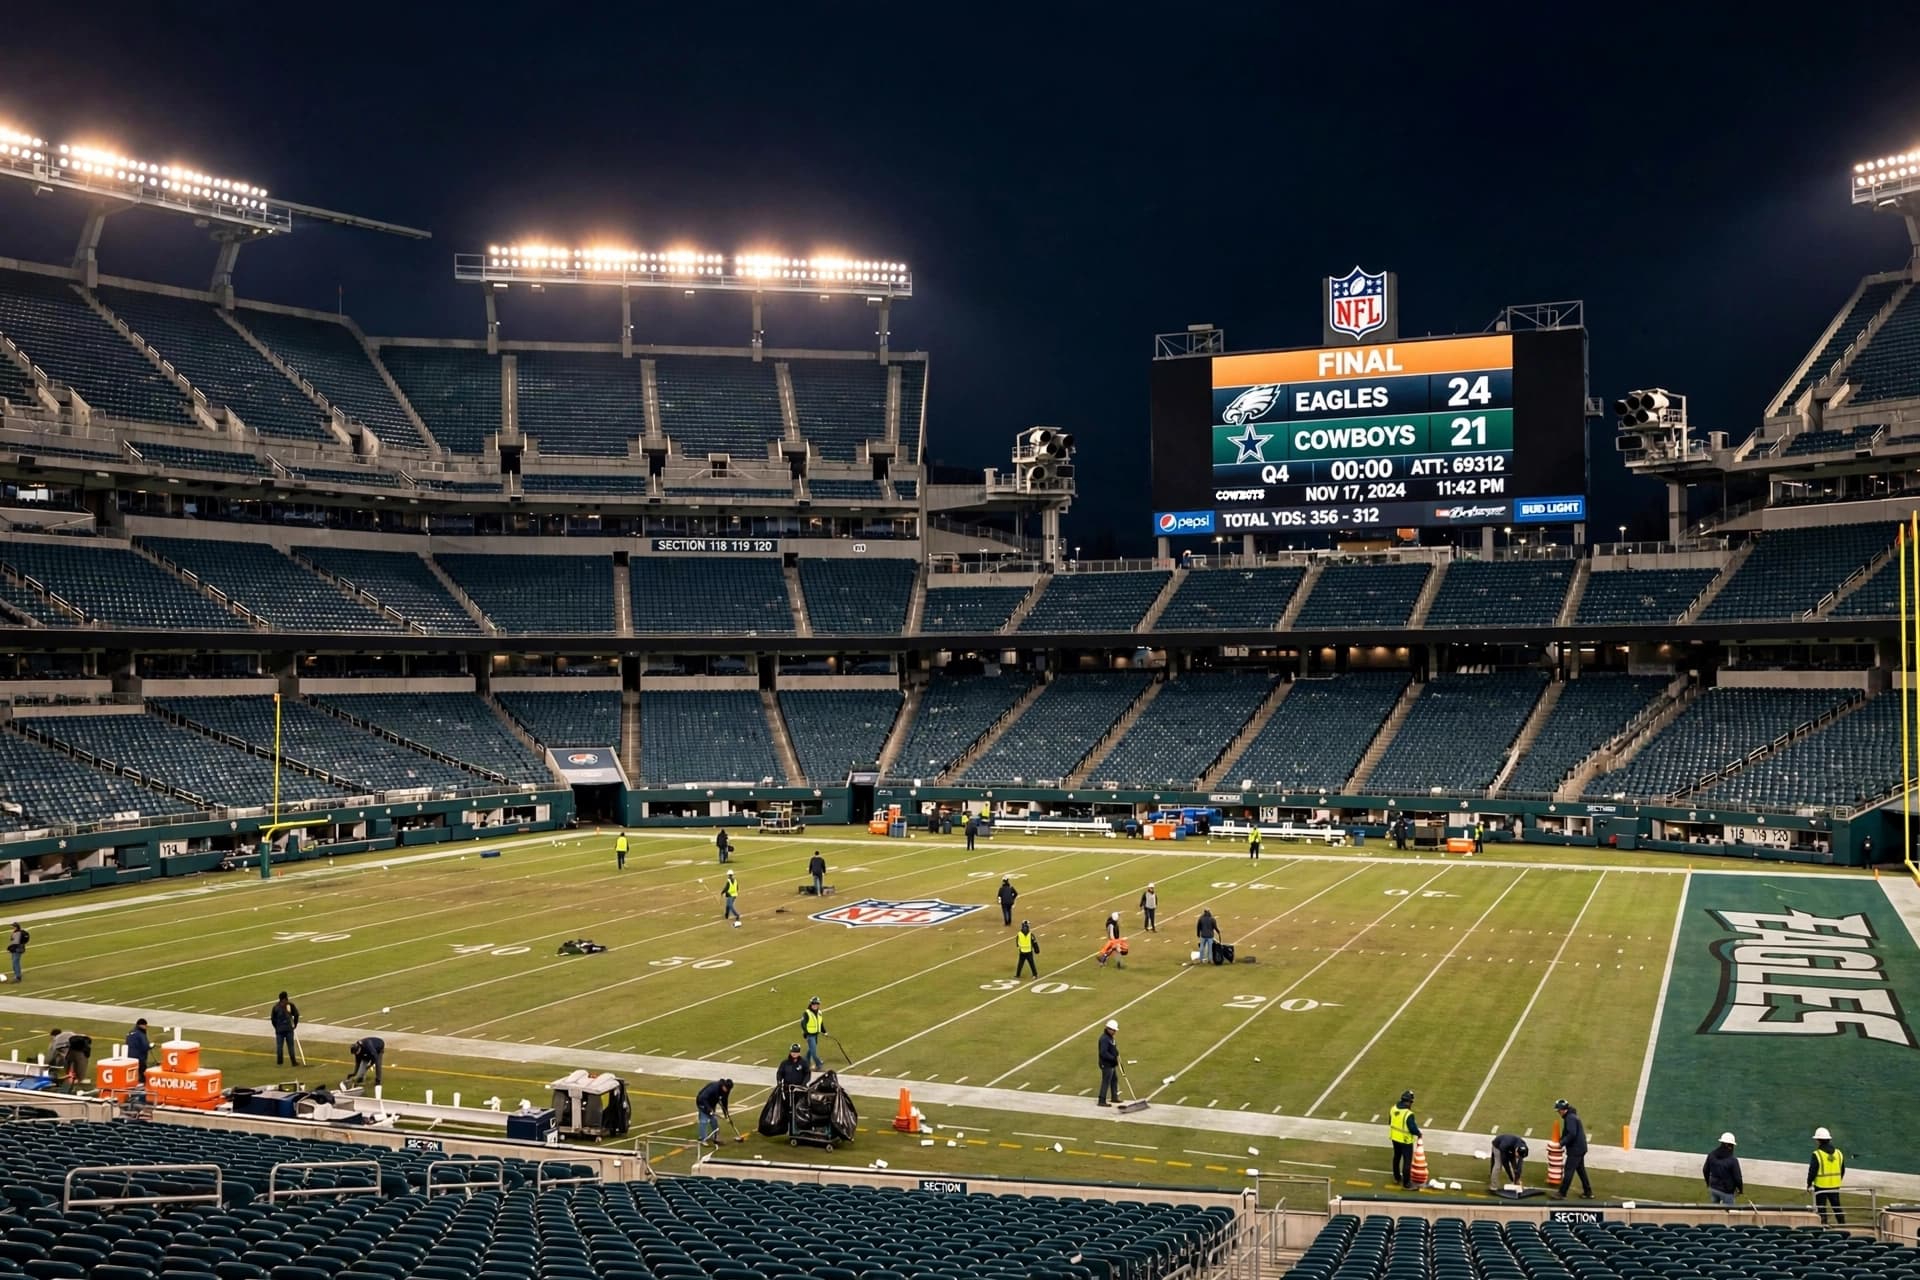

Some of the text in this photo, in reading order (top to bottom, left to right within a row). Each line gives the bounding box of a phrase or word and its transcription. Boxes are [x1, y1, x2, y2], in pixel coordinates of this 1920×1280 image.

[1336, 298, 1380, 328] NFL
[1318, 348, 1403, 376] FINAL
[1295, 376, 1492, 412] EAGLES 24
[1294, 416, 1486, 451] COWBOYS 21
[1331, 459, 1393, 480] 00:00
[1411, 456, 1505, 475] ATT: 69312
[1261, 465, 1289, 484] Q4
[1305, 482, 1406, 502] NOV 17, 2024
[1436, 478, 1504, 495] 11:42 PM
[1223, 513, 1269, 527] TOTAL
[1272, 511, 1306, 526] YDS:
[1310, 509, 1338, 525] 356
[1352, 507, 1379, 523] 312
[1521, 504, 1545, 515] BUD
[1546, 503, 1579, 514] LIGHT
[1177, 515, 1209, 529] pepsi
[658, 540, 772, 551] SECTION 118 119 120
[831, 907, 931, 923] NFL
[1703, 906, 1918, 1048] EAGLES
[980, 980, 1069, 993] 30
[1222, 995, 1319, 1011] 20
[167, 1052, 178, 1066] G
[102, 1069, 113, 1083] G
[923, 1182, 961, 1193] SECTION
[1555, 1212, 1598, 1224] SECTION
